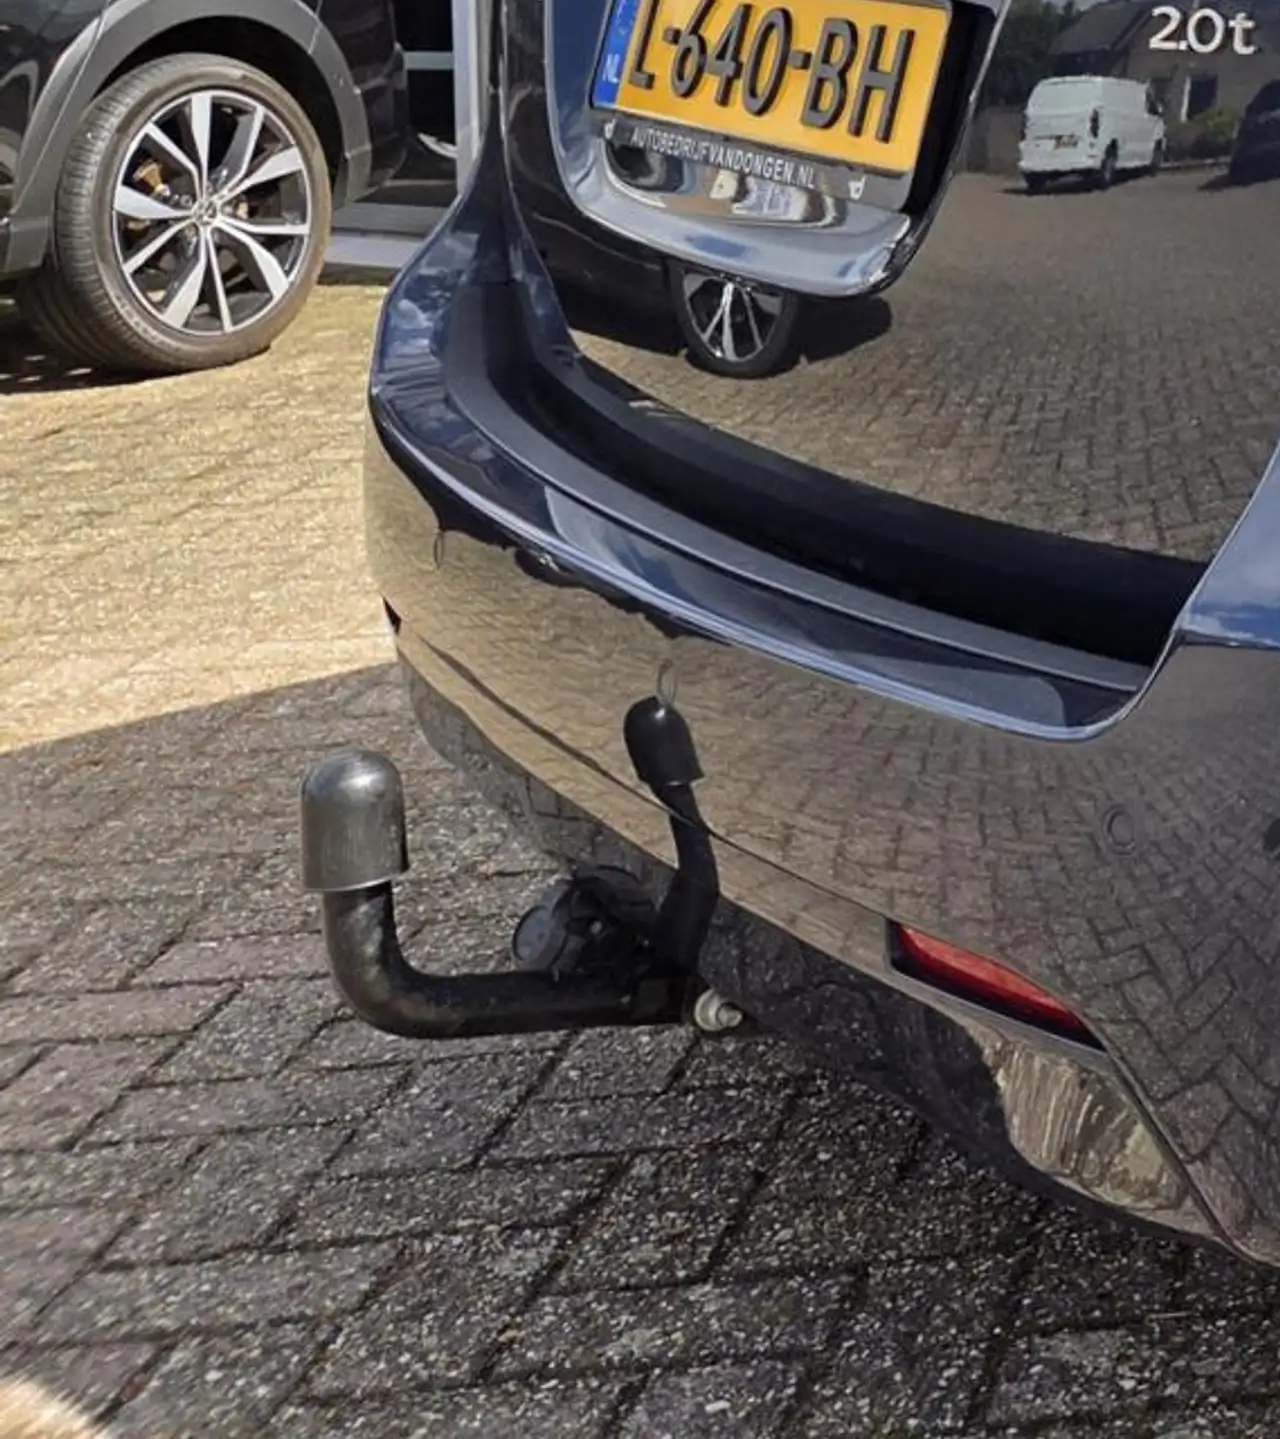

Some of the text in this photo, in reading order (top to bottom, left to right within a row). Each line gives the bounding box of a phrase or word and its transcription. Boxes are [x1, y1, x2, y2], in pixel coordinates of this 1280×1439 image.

[1148, 5, 1257, 56] 2.0t
[602, 53, 620, 84] NL
[630, 126, 817, 189] AUTOBEDRIJFVANDONGEN.NL
